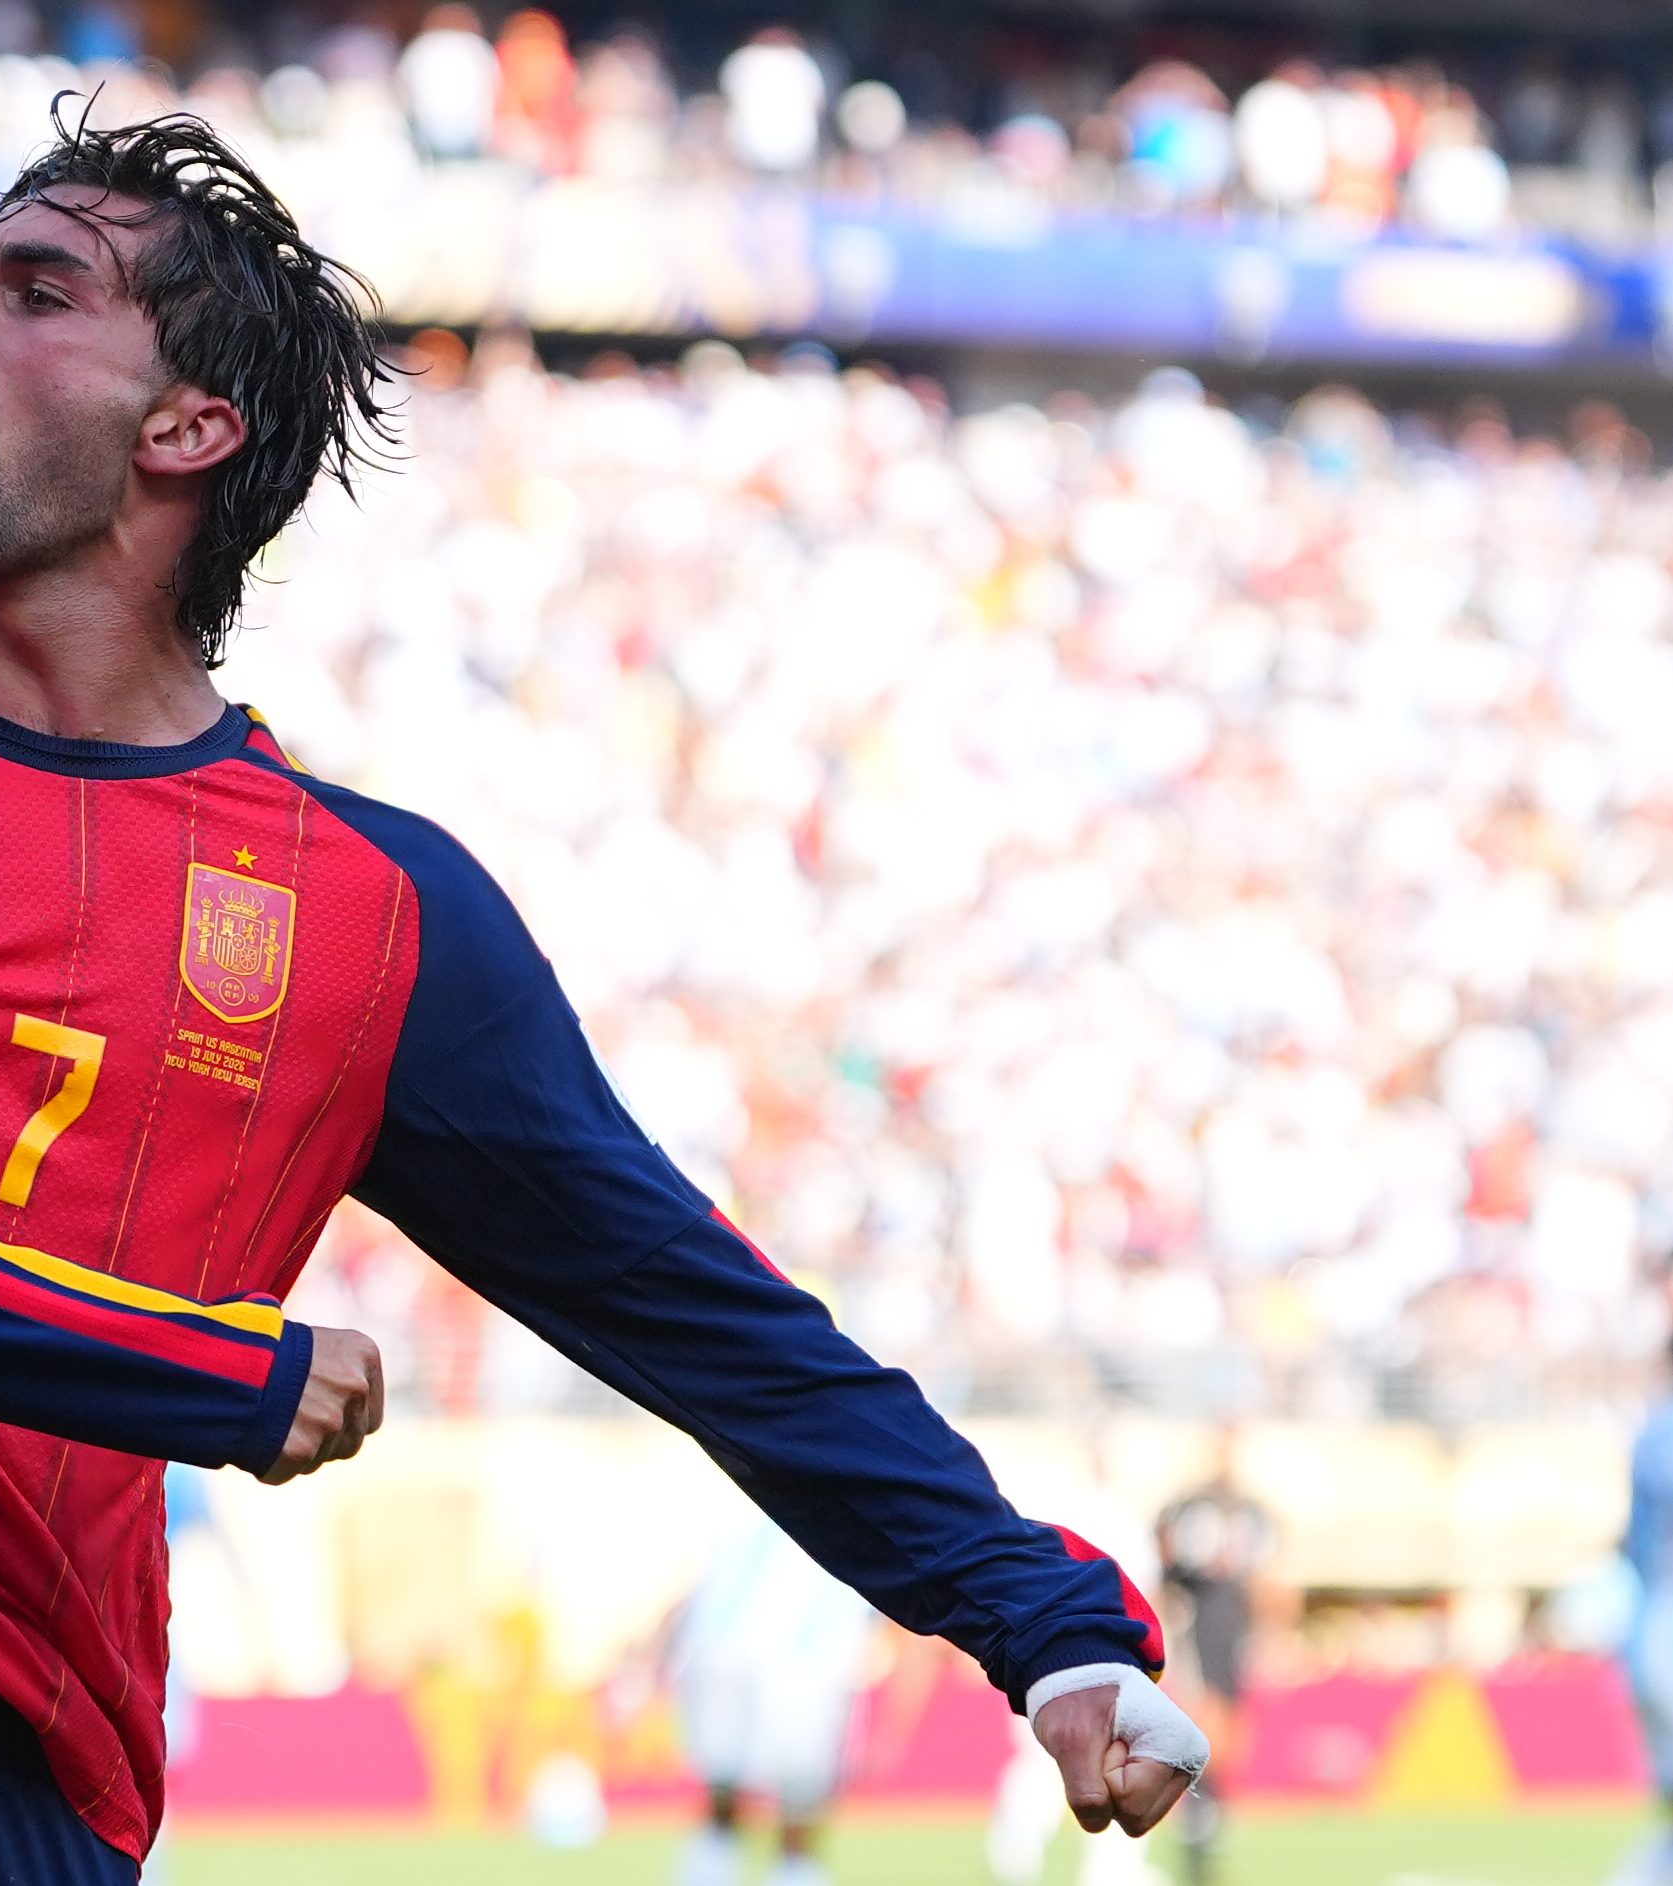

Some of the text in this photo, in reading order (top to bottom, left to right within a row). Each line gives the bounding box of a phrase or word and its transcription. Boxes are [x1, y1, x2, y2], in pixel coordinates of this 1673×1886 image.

[177, 1029, 204, 1045] SPAIN
[219, 1040, 263, 1063] ARGENTINA
[191, 1046, 246, 1072] 19 JULY 2026
[164, 1054, 186, 1069] NEW
[188, 1060, 210, 1076] YORK
[212, 1067, 233, 1082] NEW
